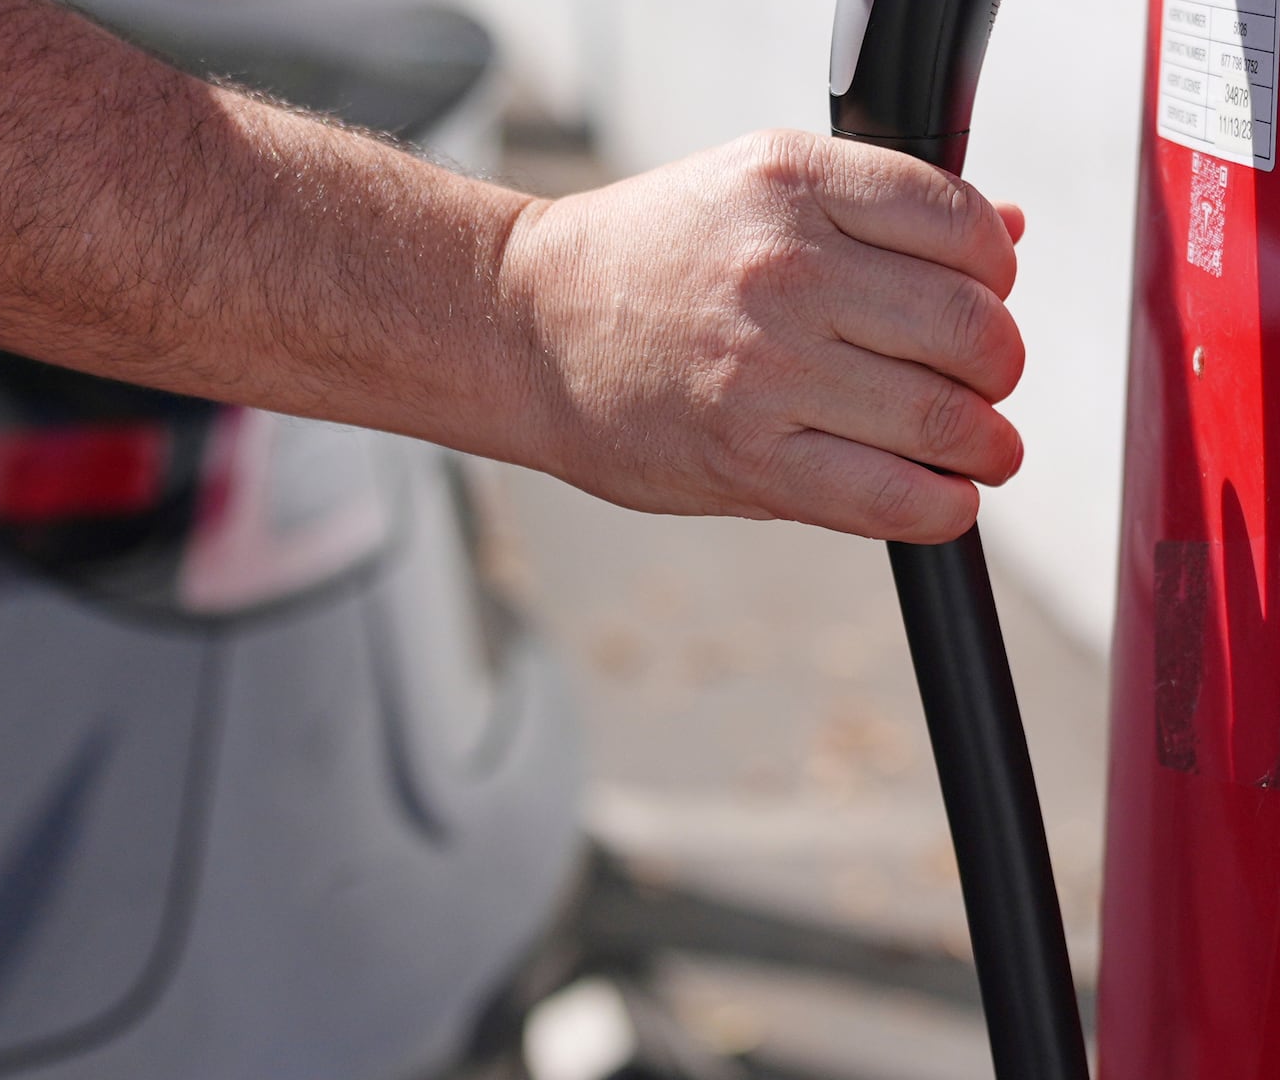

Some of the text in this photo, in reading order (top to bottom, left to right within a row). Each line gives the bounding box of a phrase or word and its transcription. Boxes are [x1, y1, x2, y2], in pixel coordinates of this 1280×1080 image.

[1185, 11, 1206, 27] NUMBER
[1186, 45, 1207, 60] NUMBER
[1221, 53, 1231, 67] 877
[1244, 58, 1259, 74] 3752
[1225, 83, 1249, 108] 34878
[1219, 116, 1253, 140] 11/13/23
